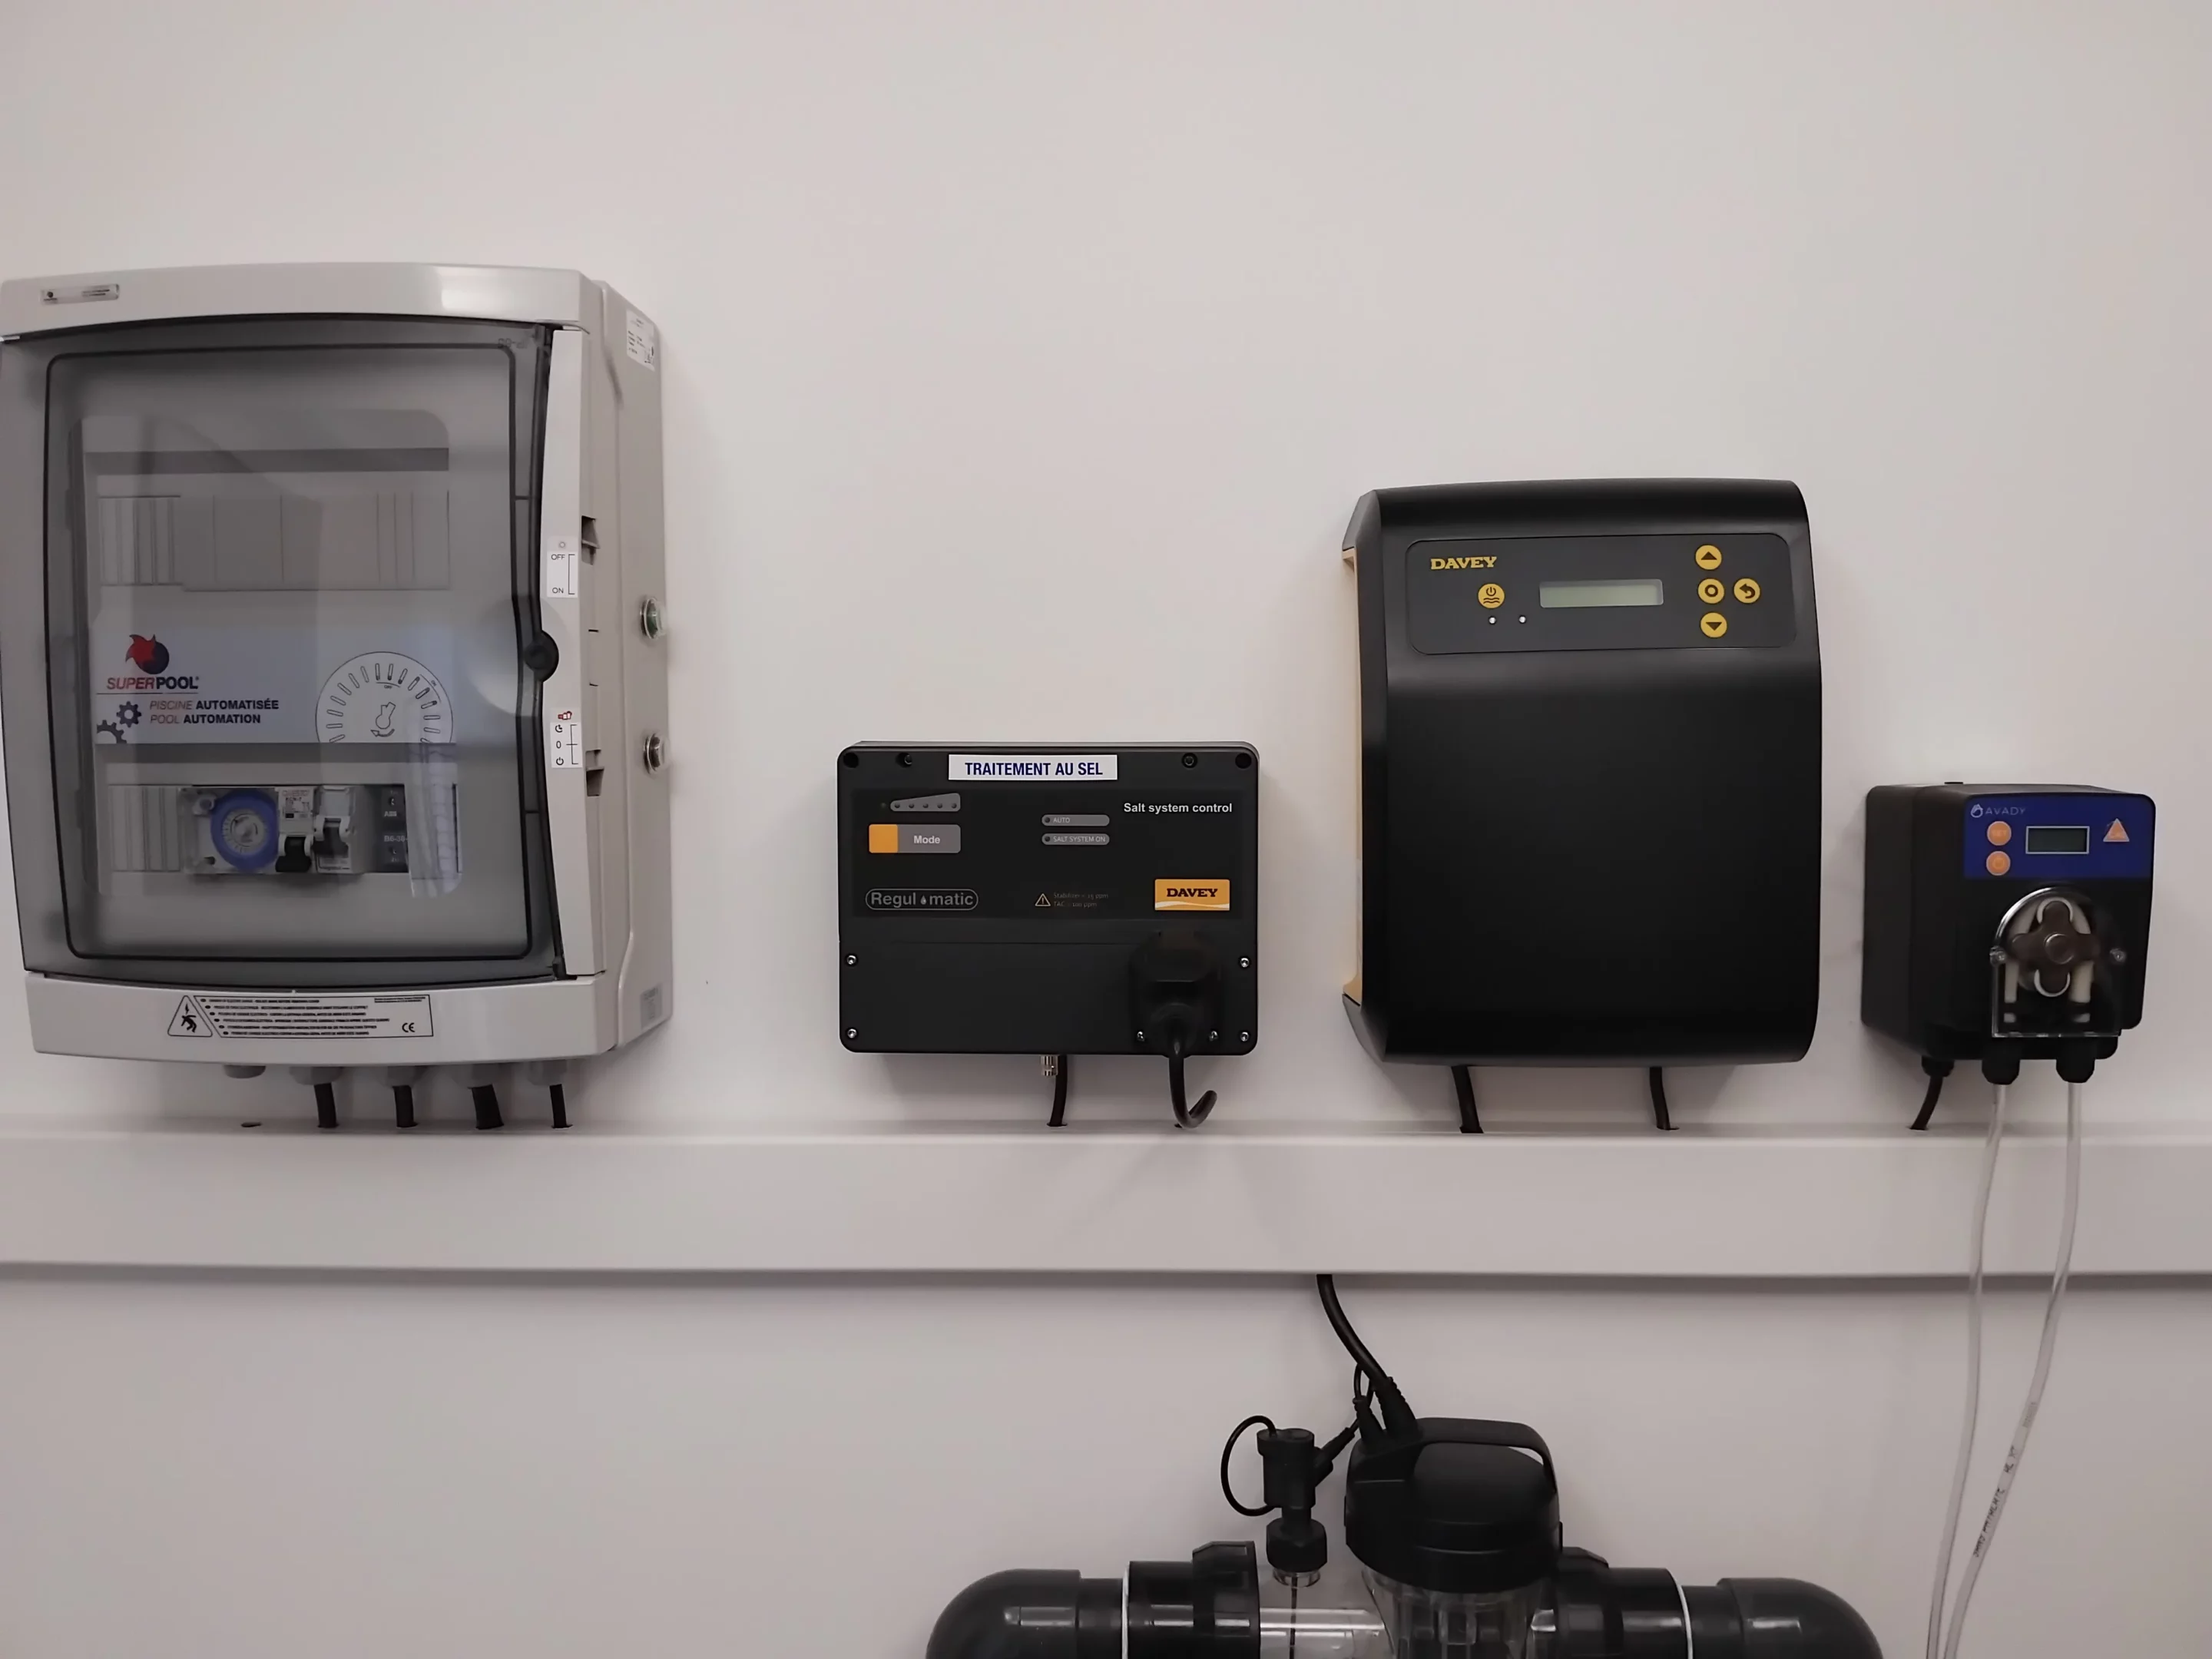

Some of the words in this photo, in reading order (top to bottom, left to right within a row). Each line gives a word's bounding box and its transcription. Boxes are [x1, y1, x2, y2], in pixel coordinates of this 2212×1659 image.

[1430, 556, 1497, 570] DAVEY
[149, 700, 193, 710] PISCINE
[195, 697, 280, 710] AUTOMATISÉE
[150, 714, 180, 724] POOL
[183, 714, 261, 724] AUTOMATION
[965, 762, 1051, 776] TRAITEMENT
[1055, 762, 1074, 776] AU
[1078, 762, 1103, 776] SEL
[1124, 803, 1145, 813] Salt
[1148, 803, 1189, 815] system
[1192, 803, 1233, 813] control
[1985, 806, 2026, 816] AVADY
[913, 835, 941, 844] Mode
[1166, 888, 1218, 897] DAVEY
